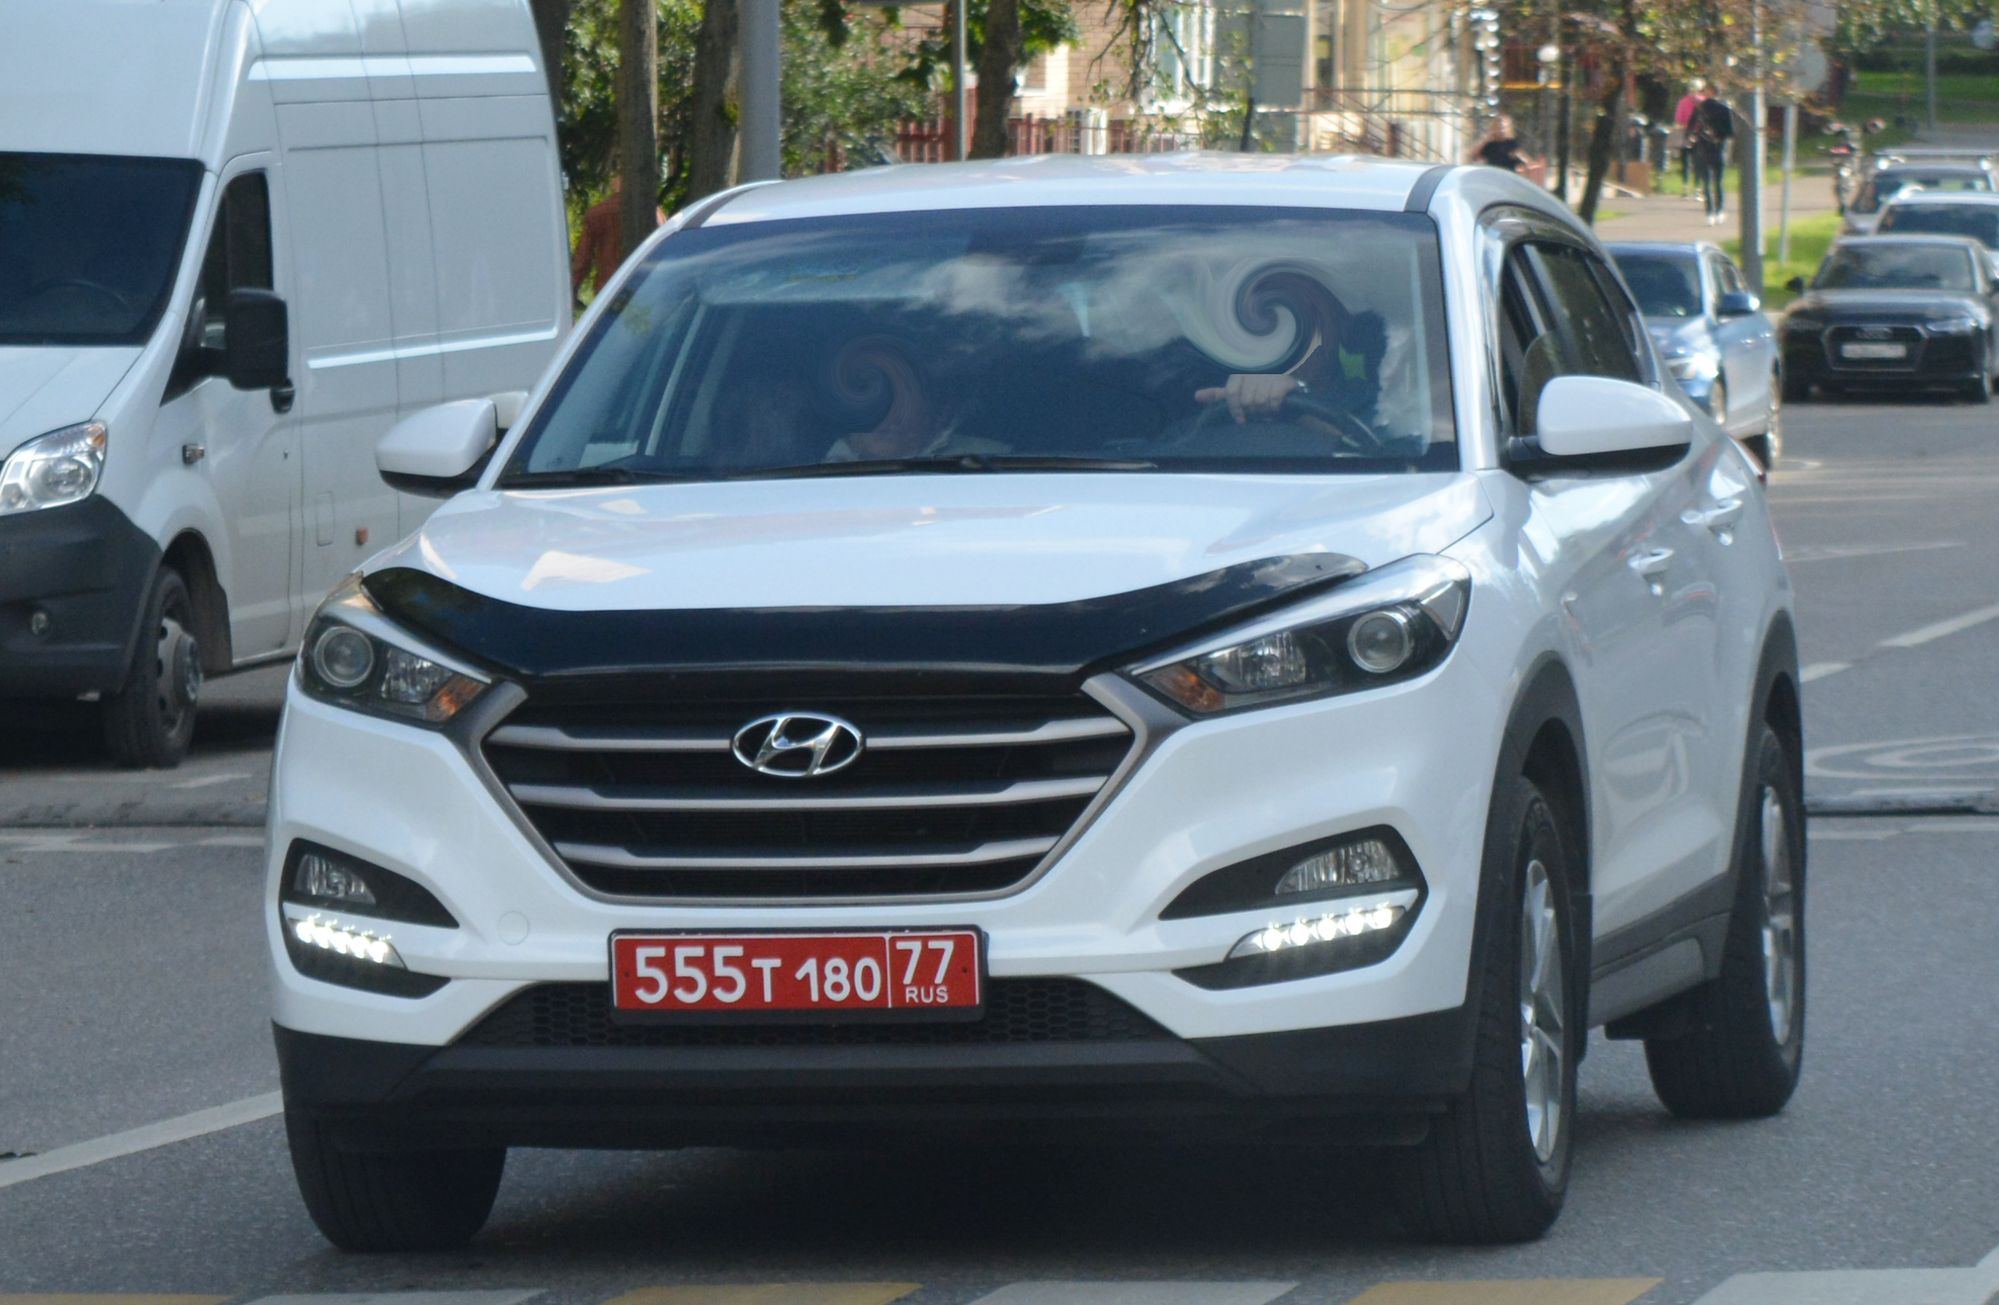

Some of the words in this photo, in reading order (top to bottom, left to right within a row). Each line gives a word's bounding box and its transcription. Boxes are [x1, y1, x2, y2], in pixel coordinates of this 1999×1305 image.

[795, 957, 881, 1002] 180
[895, 940, 954, 985] 77
[905, 986, 949, 1003] RUS
